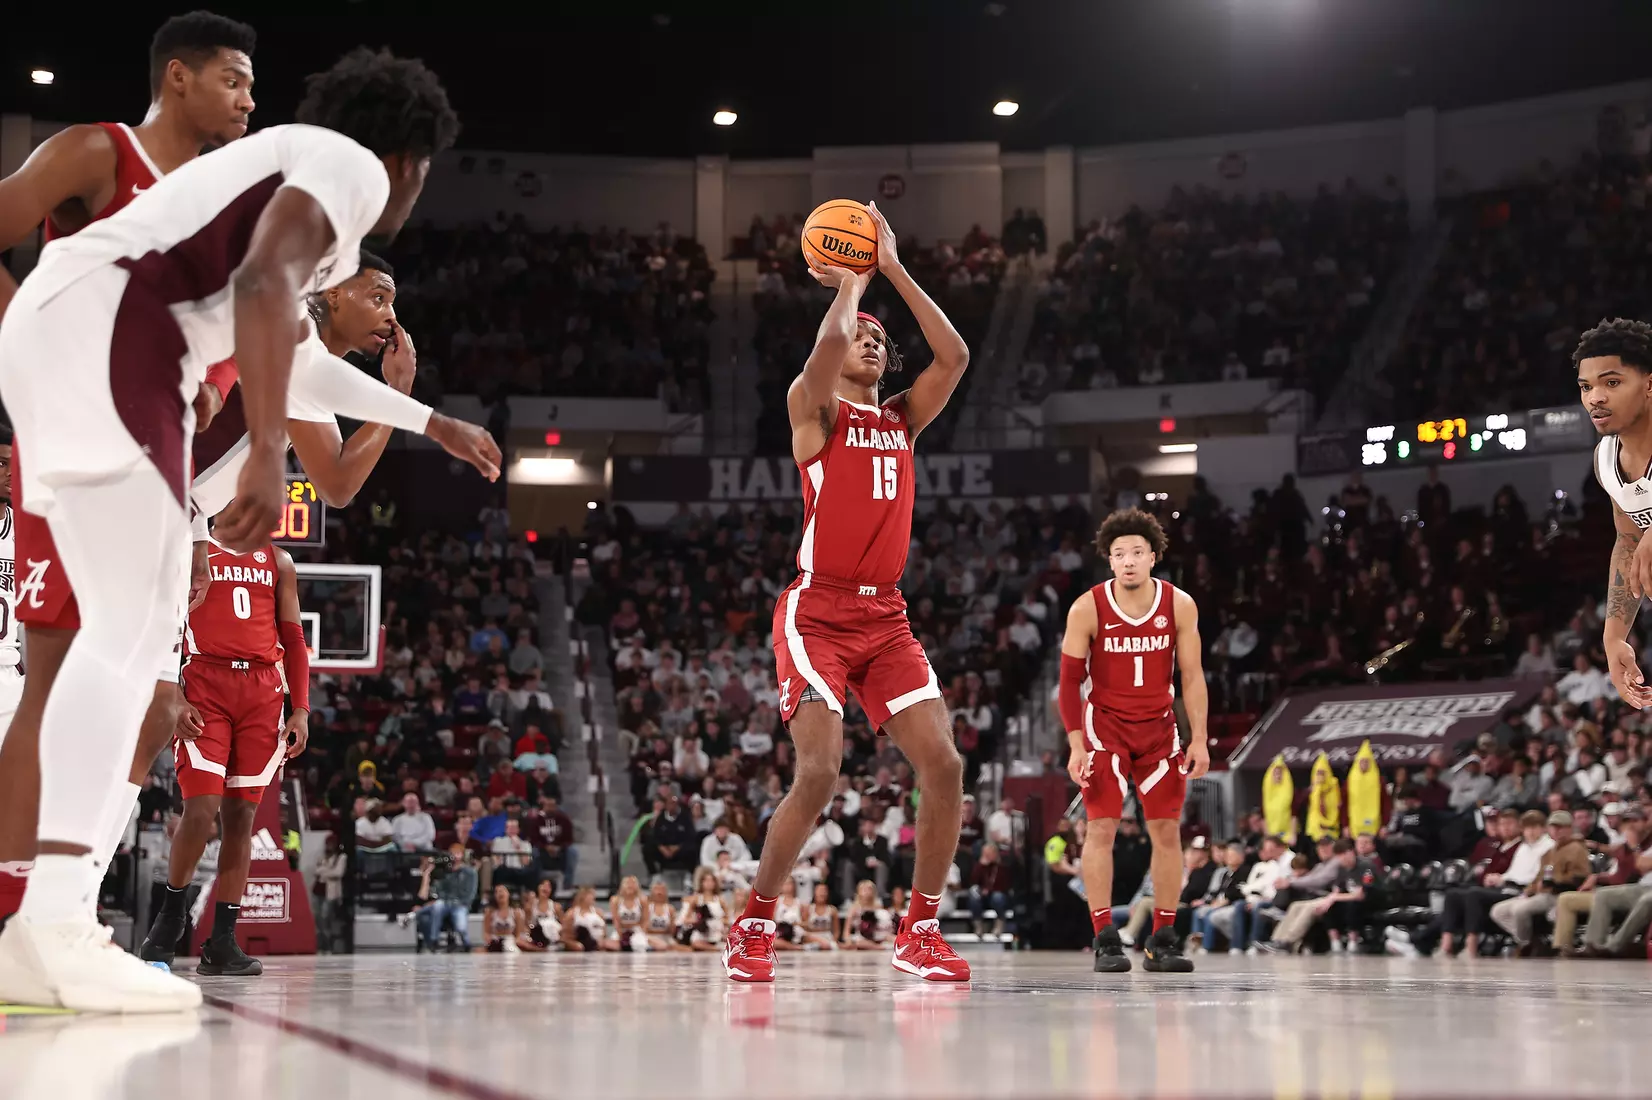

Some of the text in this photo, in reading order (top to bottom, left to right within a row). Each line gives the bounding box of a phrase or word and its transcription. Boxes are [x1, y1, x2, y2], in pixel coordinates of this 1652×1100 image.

[822, 234, 873, 261] Wilson
[845, 426, 909, 451] ALAAMA
[709, 453, 993, 498] HAI ATE
[872, 456, 898, 500] 15
[233, 587, 251, 619] 0
[1103, 634, 1170, 653] ALABAMA
[1133, 656, 1144, 687] 1
